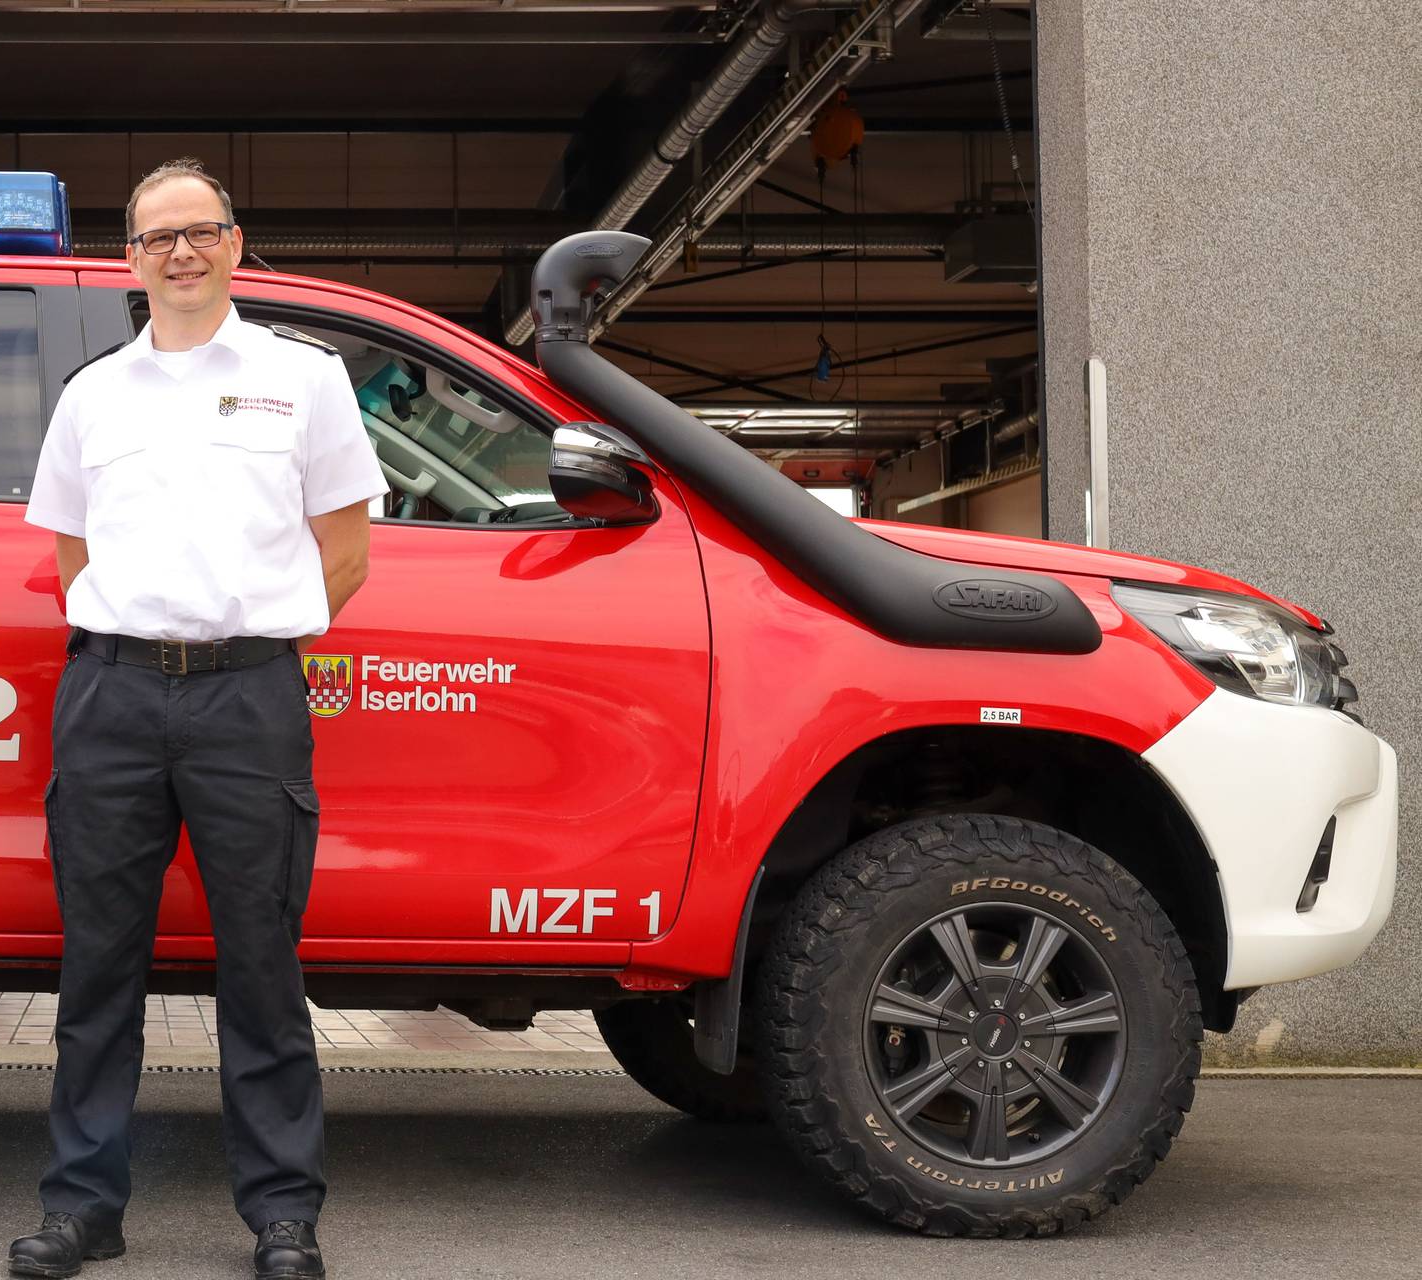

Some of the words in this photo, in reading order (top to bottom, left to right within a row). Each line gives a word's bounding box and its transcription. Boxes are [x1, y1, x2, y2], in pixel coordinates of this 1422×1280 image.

[238, 397, 294, 409] FEUERWEHR
[275, 409, 293, 417] Kreis
[949, 583, 1043, 611] SAFARI
[361, 655, 516, 683] Feuerwehr
[361, 685, 476, 712] Iserlohn
[982, 710, 996, 721] 2,5
[998, 711, 1019, 721] BAR
[490, 888, 617, 934] MZF
[640, 891, 661, 935] 1
[950, 877, 1118, 942] BFGoodrich
[865, 1113, 898, 1153] T/A
[906, 1156, 1064, 1193] All-Terrain
